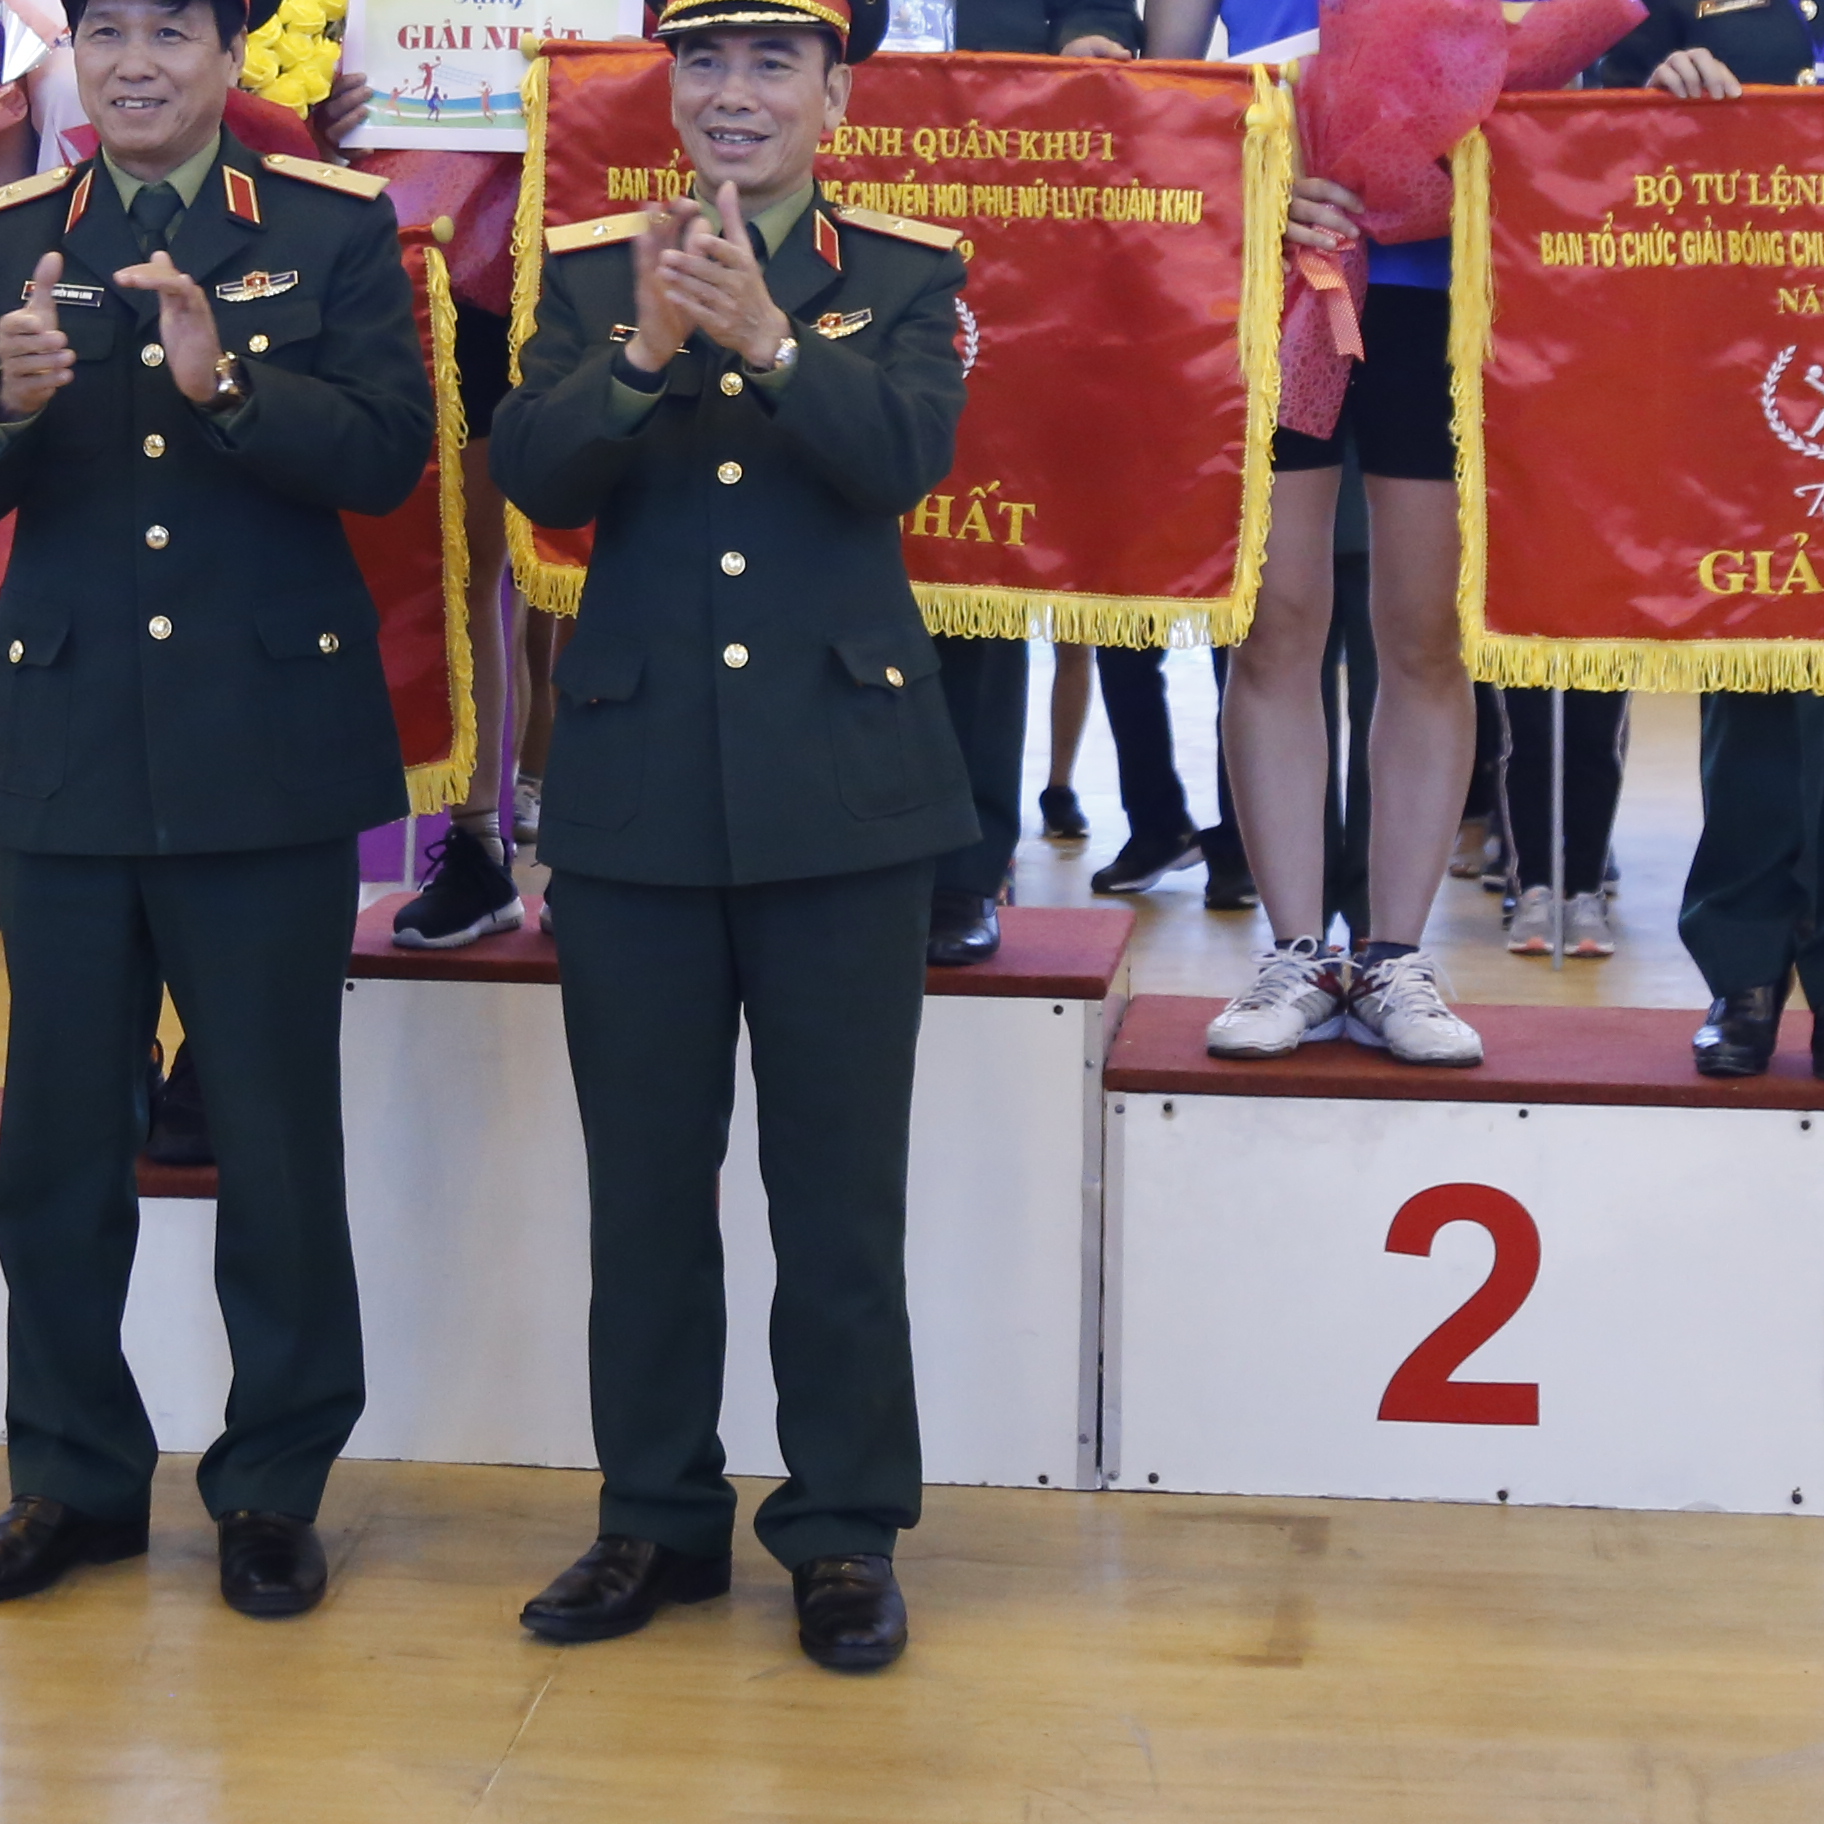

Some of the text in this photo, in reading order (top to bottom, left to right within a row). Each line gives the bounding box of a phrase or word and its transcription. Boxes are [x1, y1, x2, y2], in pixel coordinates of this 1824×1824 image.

[397, 19, 474, 50] GIẢI
[913, 119, 1009, 162] QUÂN
[1018, 129, 1091, 161] KHU
[1100, 129, 1113, 160] 1
[608, 167, 650, 201] BAN
[654, 148, 681, 202] TỔ
[934, 182, 967, 217] HƠI
[973, 185, 1012, 230] PHỤ
[1019, 178, 1049, 220] NỮ
[1052, 186, 1096, 221] LLVT
[1102, 182, 1156, 221] QUÂN
[1161, 187, 1202, 224] KHU
[1633, 166, 1682, 213] BỘ
[1692, 170, 1740, 203] TƯ
[1541, 230, 1583, 266] BAN
[1590, 213, 1617, 265] TỔ
[1622, 221, 1676, 267] CHỨC
[1682, 217, 1722, 266] GIẢI
[1729, 221, 1785, 267] BÓNG
[899, 480, 1036, 546] HẤT
[1377, 1182, 1542, 1426] 2
